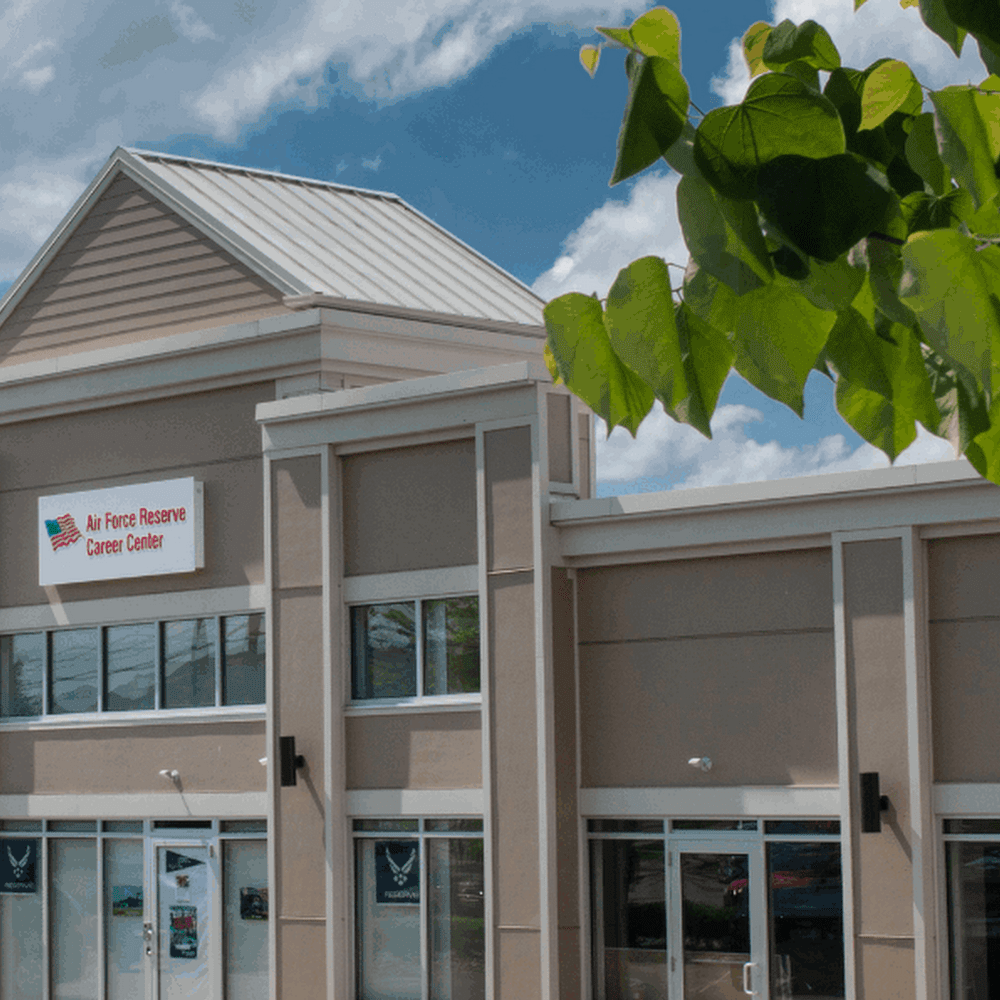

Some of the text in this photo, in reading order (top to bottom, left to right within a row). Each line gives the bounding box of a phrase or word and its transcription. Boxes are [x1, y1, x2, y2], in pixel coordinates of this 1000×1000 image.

[86, 506, 186, 533] Air Force Reserve
[86, 532, 164, 556] Career Center
